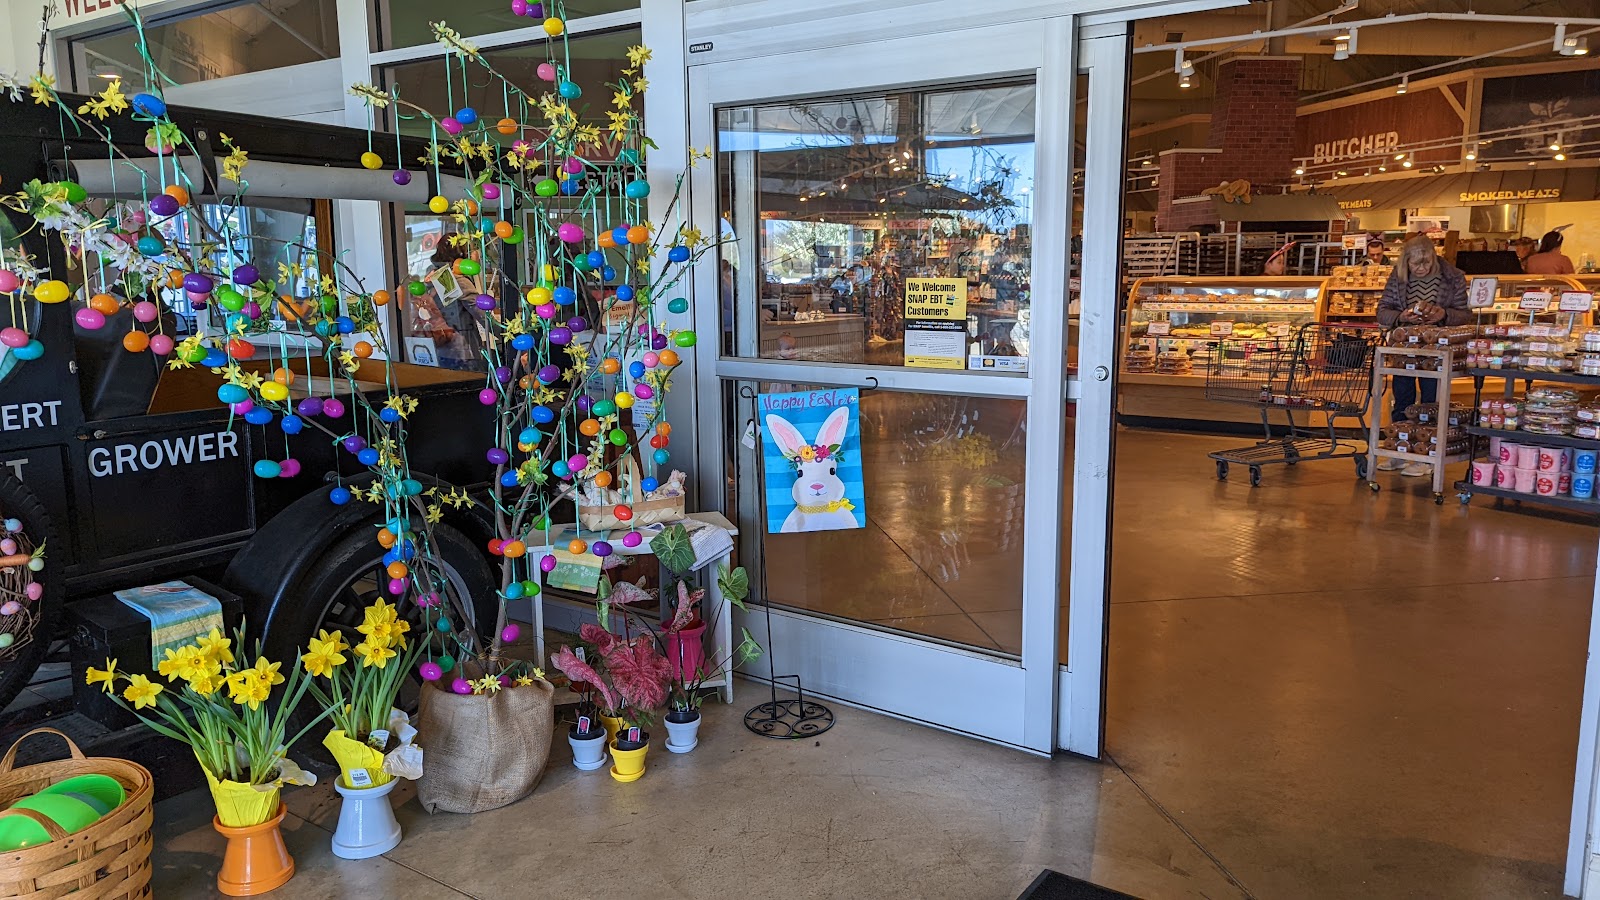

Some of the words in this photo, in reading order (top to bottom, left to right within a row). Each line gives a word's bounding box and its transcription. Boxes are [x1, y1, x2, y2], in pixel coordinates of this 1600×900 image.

[690, 43, 712, 52] STANLEY
[1314, 131, 1399, 164] BUTCHER
[1460, 190, 1514, 202] SMOKED
[1517, 188, 1560, 199] MEATS
[908, 282, 920, 292] We
[922, 282, 956, 292] Welcome
[907, 294, 928, 304] SNAP
[930, 294, 944, 304] EBT
[907, 306, 949, 316] Customers
[763, 394, 805, 413] Happy
[809, 390, 853, 408] Easter
[0, 400, 62, 432] ERT
[88, 430, 239, 478] GROWER
